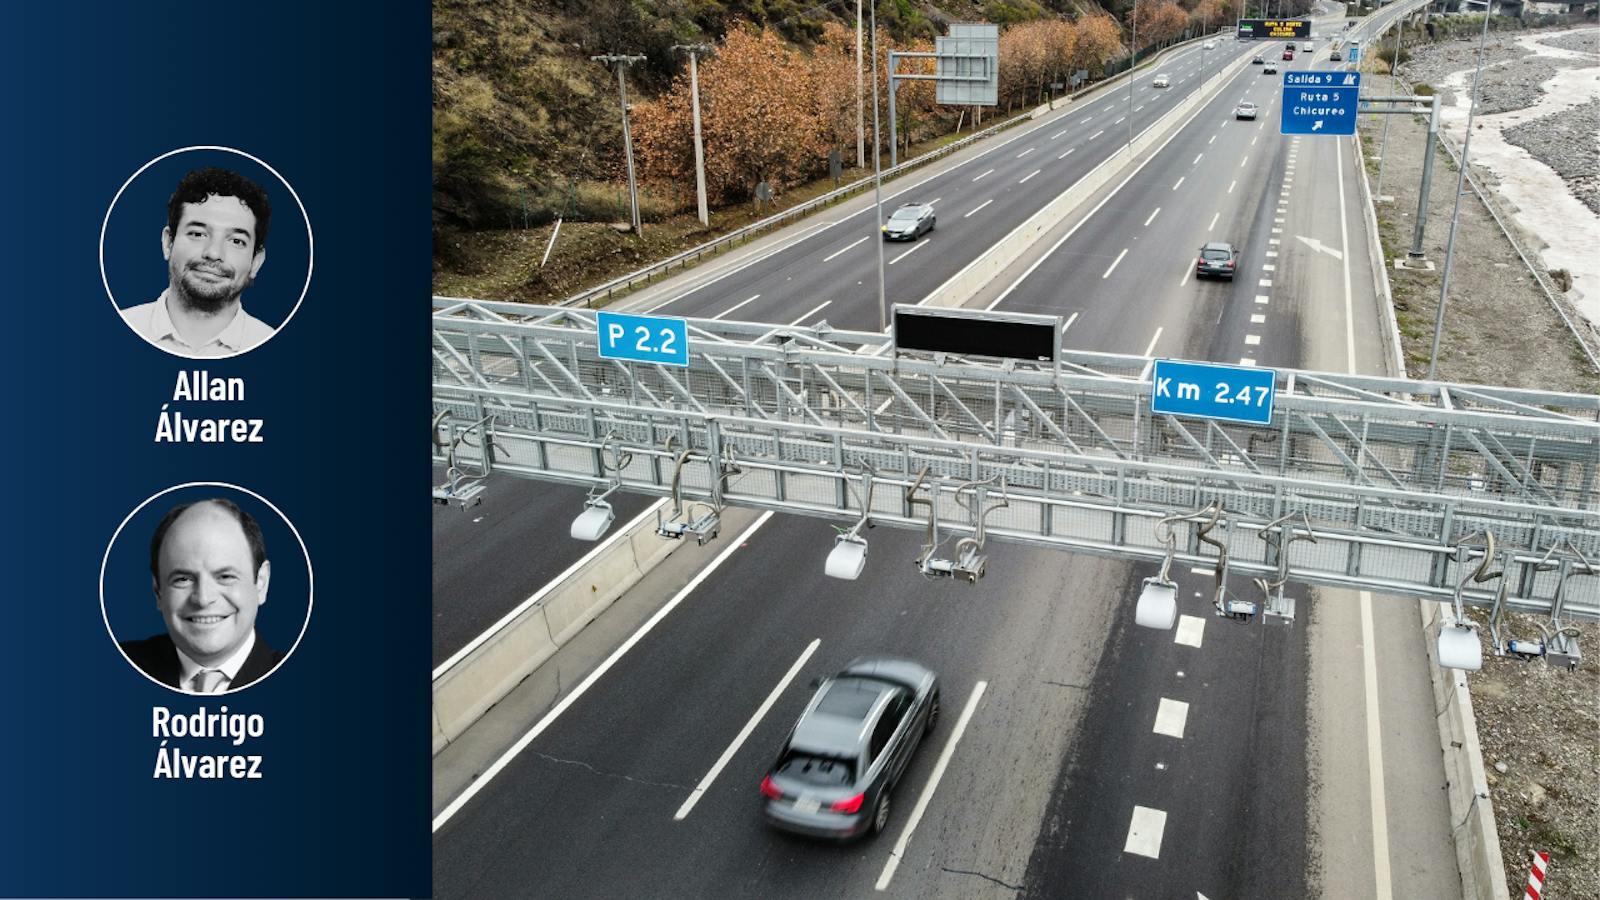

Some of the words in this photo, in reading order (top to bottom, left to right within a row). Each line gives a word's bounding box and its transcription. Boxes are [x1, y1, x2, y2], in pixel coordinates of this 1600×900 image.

[1287, 74, 1321, 84] Salida
[1325, 74, 1333, 83] 9
[1300, 92, 1329, 102] Ruta
[1333, 92, 1340, 101] 5
[1293, 106, 1345, 116] Chicureo
[608, 323, 624, 348] P
[635, 325, 677, 354] 2.2
[1156, 376, 1200, 401] Km
[1214, 382, 1270, 408] 2.47
